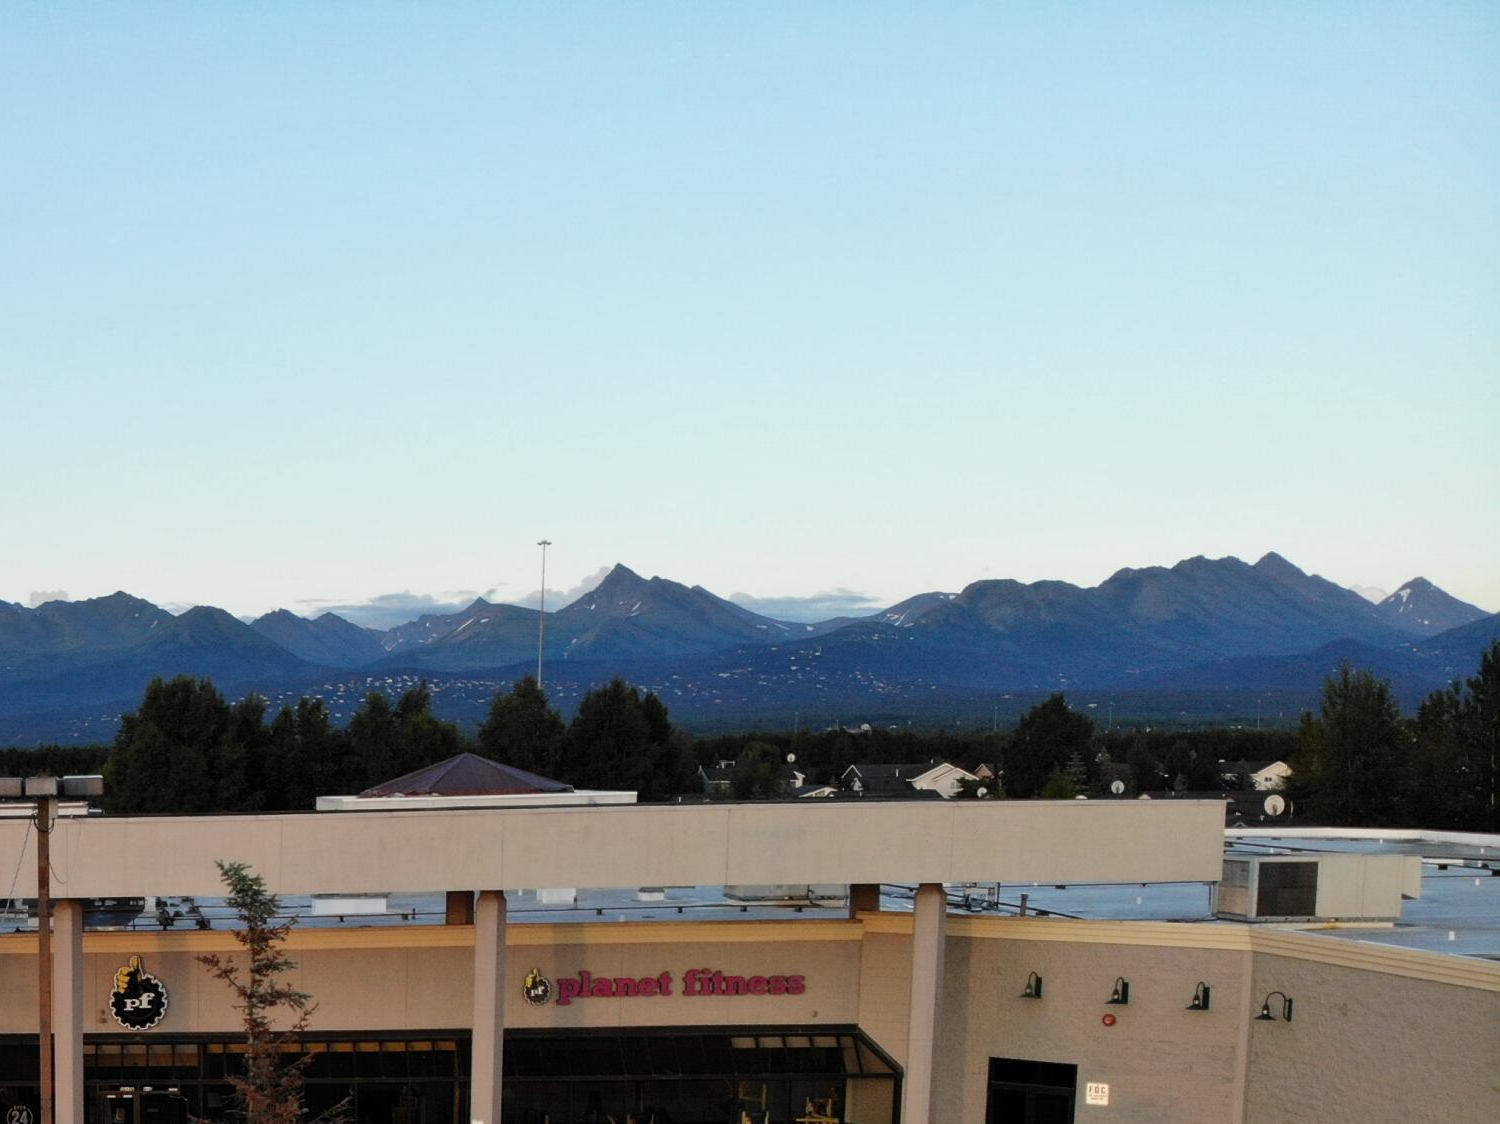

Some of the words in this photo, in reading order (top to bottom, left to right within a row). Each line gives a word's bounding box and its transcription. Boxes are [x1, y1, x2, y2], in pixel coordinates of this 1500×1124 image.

[556, 971, 673, 1005] planet
[683, 968, 806, 997] fitness
[123, 992, 155, 1011] pf
